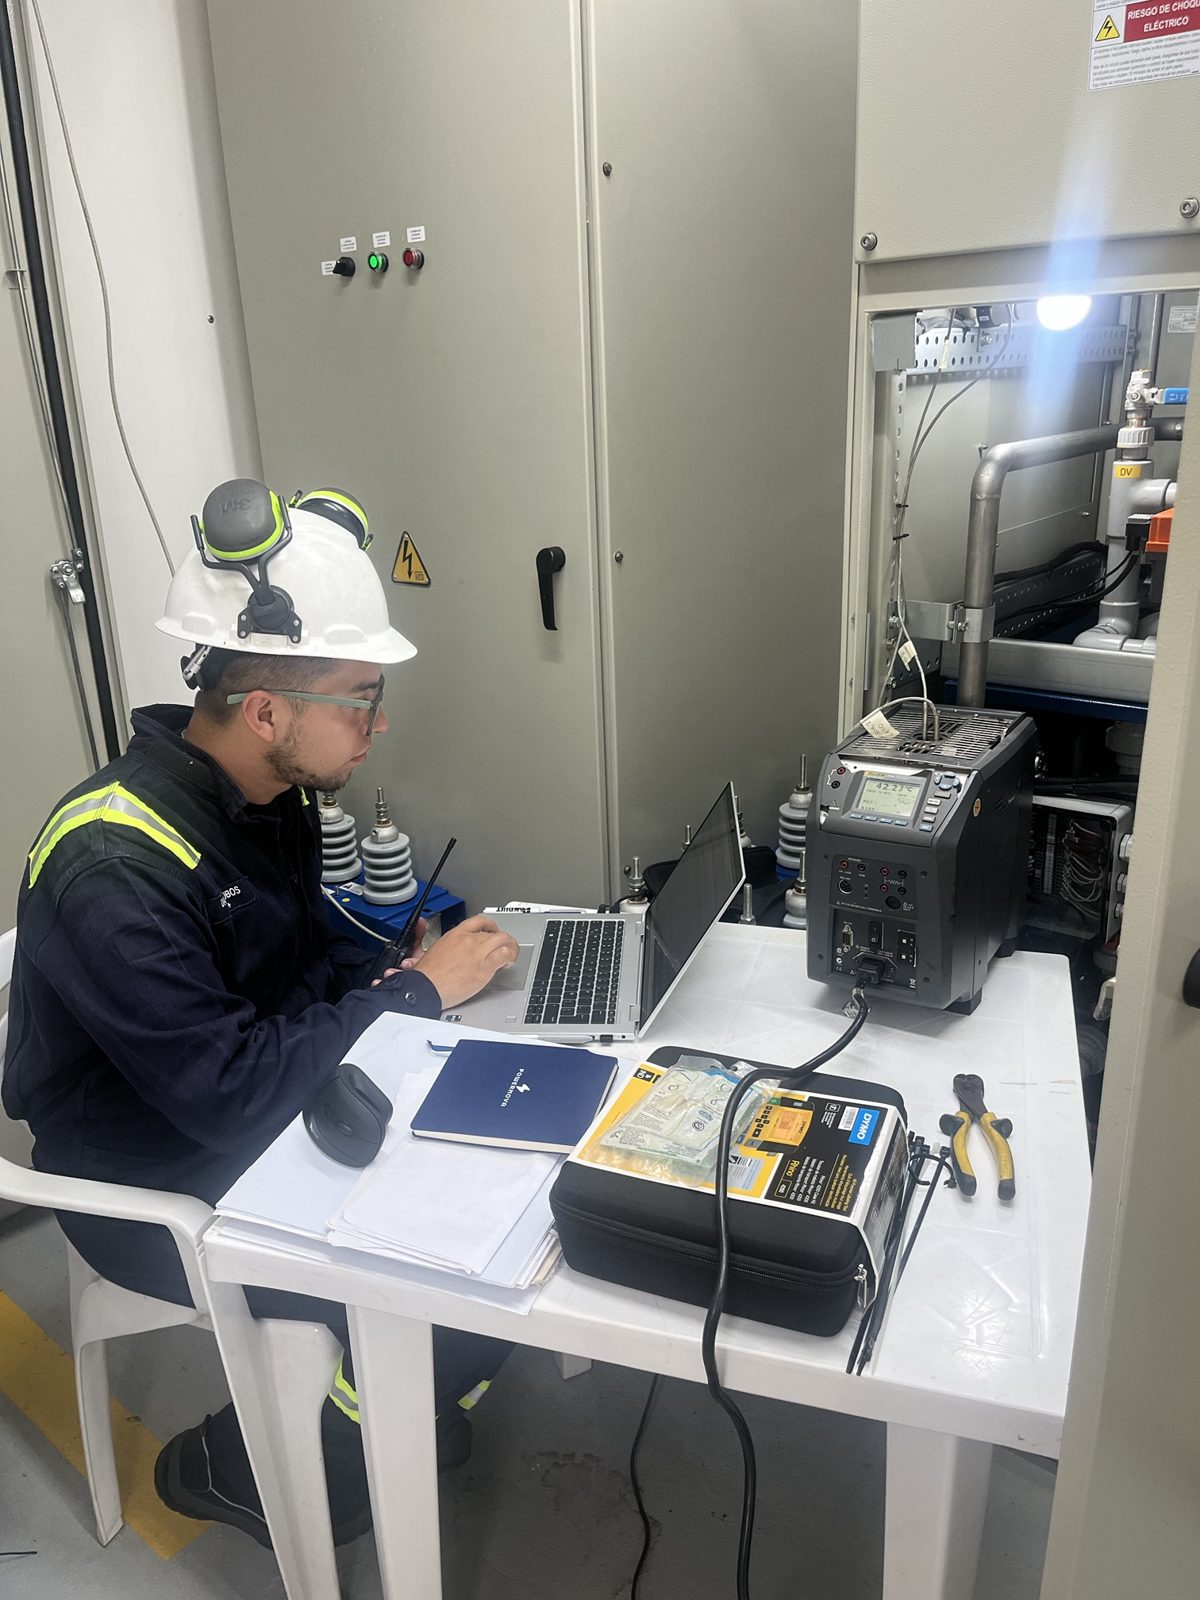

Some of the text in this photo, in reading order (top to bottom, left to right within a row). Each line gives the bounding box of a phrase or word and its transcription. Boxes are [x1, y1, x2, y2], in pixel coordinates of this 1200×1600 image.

[1127, 7, 1158, 20] RIESGO
[1159, 4, 1171, 14] DE
[1143, 16, 1189, 32] ELÉCTRICO
[1120, 467, 1133, 476] DV
[500, 1068, 525, 1107] POWERNOVA
[856, 1112, 873, 1140] DYMO
